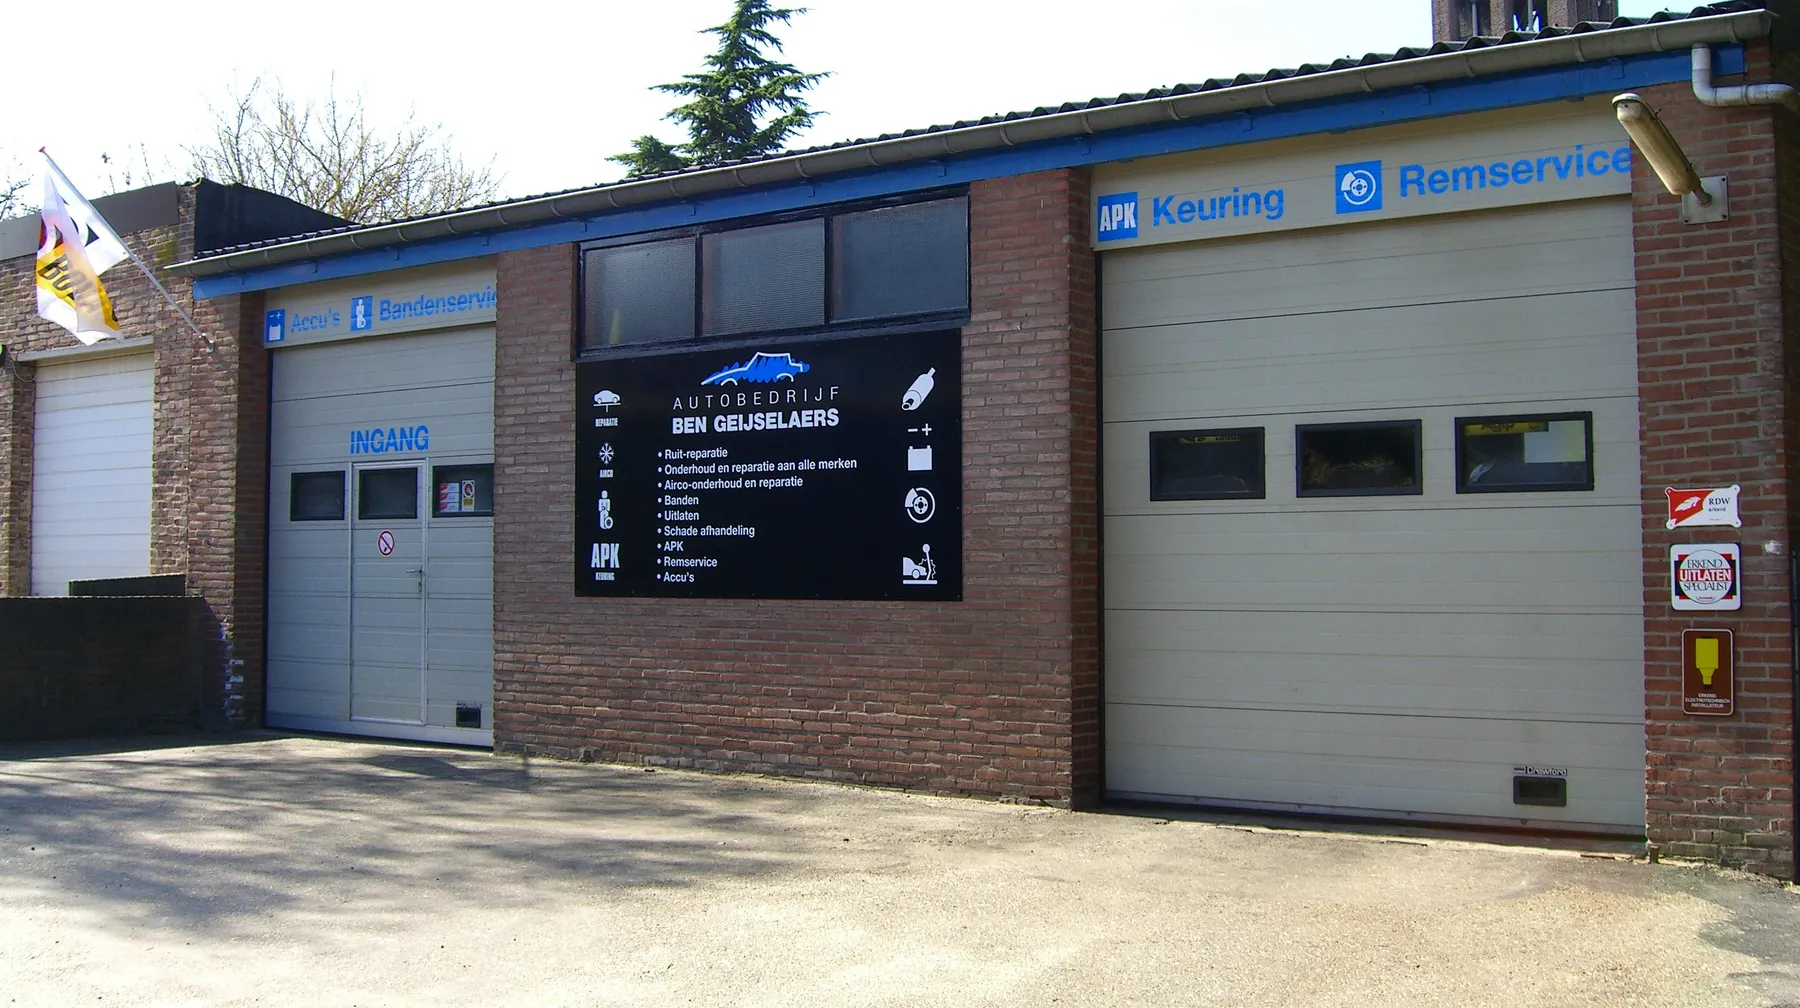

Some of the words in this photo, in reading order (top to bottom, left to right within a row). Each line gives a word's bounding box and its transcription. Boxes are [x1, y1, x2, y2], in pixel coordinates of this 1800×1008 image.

[1400, 144, 1632, 197] Remservice
[1153, 186, 1284, 227] Keuring
[1100, 202, 1137, 232] APK
[291, 308, 340, 332] Accu's
[672, 386, 839, 410] AUTOBEDRIJF
[672, 416, 707, 435] BEN
[714, 408, 839, 432] GEIJSELAERS
[350, 425, 429, 455] INGANG
[664, 447, 728, 461] Ruit-reparatie
[664, 463, 716, 475] Onderhoud
[717, 465, 729, 473] en
[732, 461, 775, 475] reparatie
[777, 462, 796, 471] aan
[798, 459, 816, 471] alle
[818, 457, 858, 469] merken
[664, 478, 742, 490] Airco-onderhoud
[744, 479, 757, 488] en
[759, 476, 803, 490] reparatie
[664, 495, 699, 506] Banden
[1708, 497, 1730, 505] RDW
[664, 510, 699, 521] Uitlaten
[664, 525, 698, 536] Schade
[700, 525, 755, 538] afhandeling
[663, 541, 684, 551] APK
[591, 543, 620, 569] APK
[664, 556, 718, 567] Remservice
[1687, 559, 1723, 568] ERKEND
[663, 572, 695, 582] Accu's
[1680, 568, 1731, 581] UITLATEN
[1684, 582, 1728, 591] SPECIALIST
